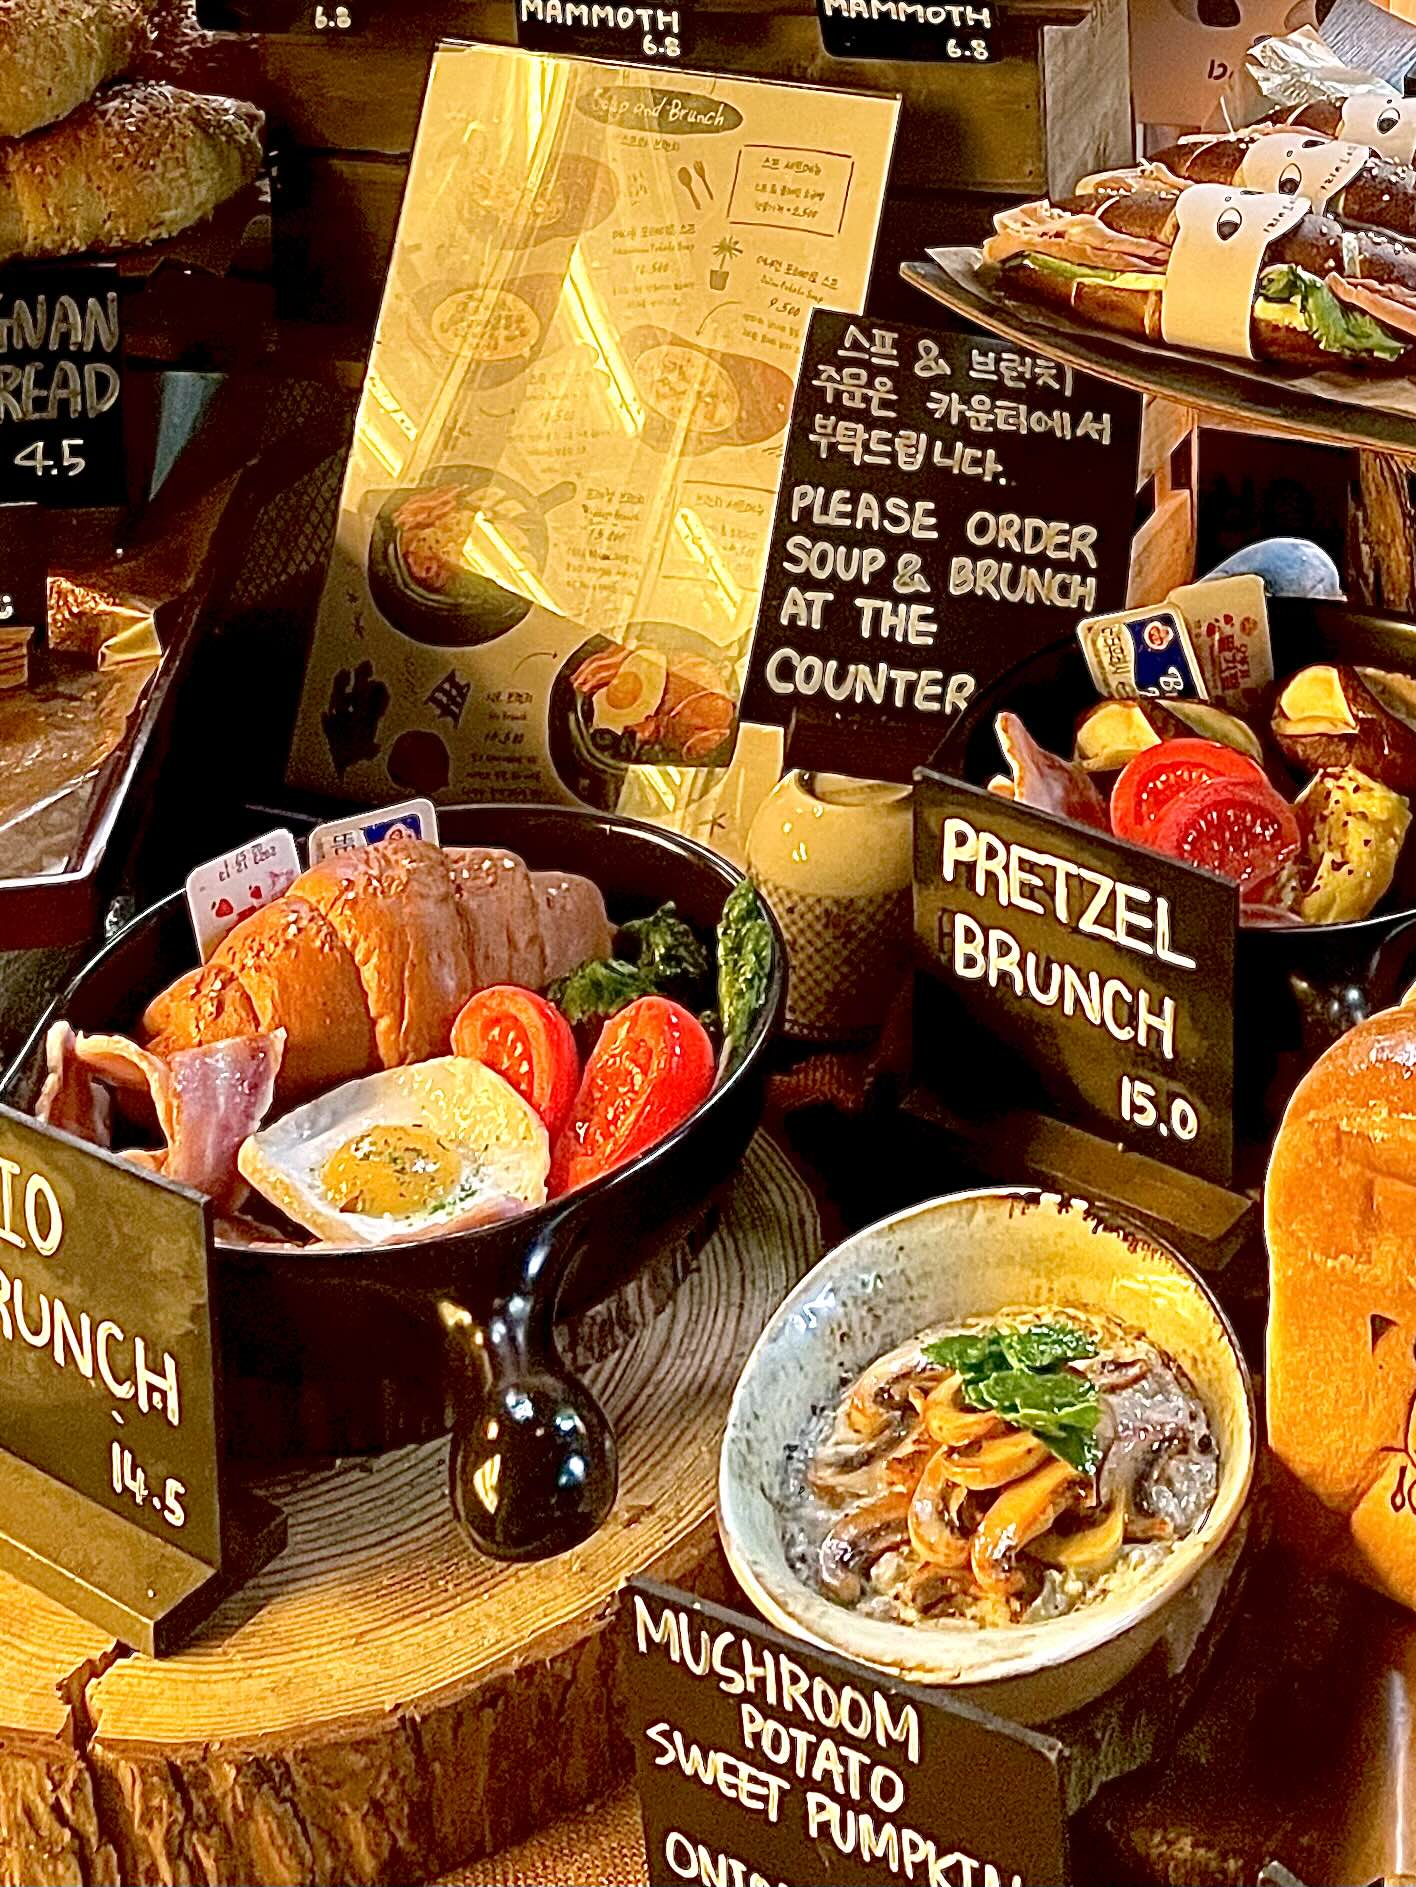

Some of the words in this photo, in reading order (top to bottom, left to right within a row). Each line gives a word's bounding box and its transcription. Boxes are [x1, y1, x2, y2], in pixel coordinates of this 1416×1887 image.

[314, 5, 352, 30] 6.8
[643, 33, 681, 57] 6.8
[946, 39, 990, 61] 6.8
[633, 97, 667, 116] and
[669, 99, 725, 127] Brunch
[0, 360, 121, 425] READ
[837, 324, 899, 367] 스프
[917, 339, 951, 378] &
[969, 348, 1074, 397] 브런치
[811, 365, 899, 418] 주문은
[926, 391, 1112, 445] 카운터에서
[14, 439, 86, 477] 4.5
[791, 486, 939, 540] PLEASE
[966, 512, 1099, 568] ORDER
[782, 535, 887, 583] SOUP
[893, 553, 931, 593] &
[949, 556, 1096, 612] BRUNCH
[780, 587, 834, 629] AT
[855, 598, 937, 646] THE
[766, 647, 976, 715] COUNTER
[941, 818, 1196, 970] PRETZEL
[952, 911, 1176, 1060] BRUNCH
[1120, 1075, 1198, 1141] 15.0
[0, 1156, 63, 1258] IO
[0, 1275, 181, 1428] RUNCH
[110, 1440, 187, 1528] 14.5
[633, 1594, 921, 1764] MUSHROOM
[645, 1721, 792, 1824] SWEET
[741, 1702, 905, 1813] POTATO
[665, 1830, 790, 1887] ONI
